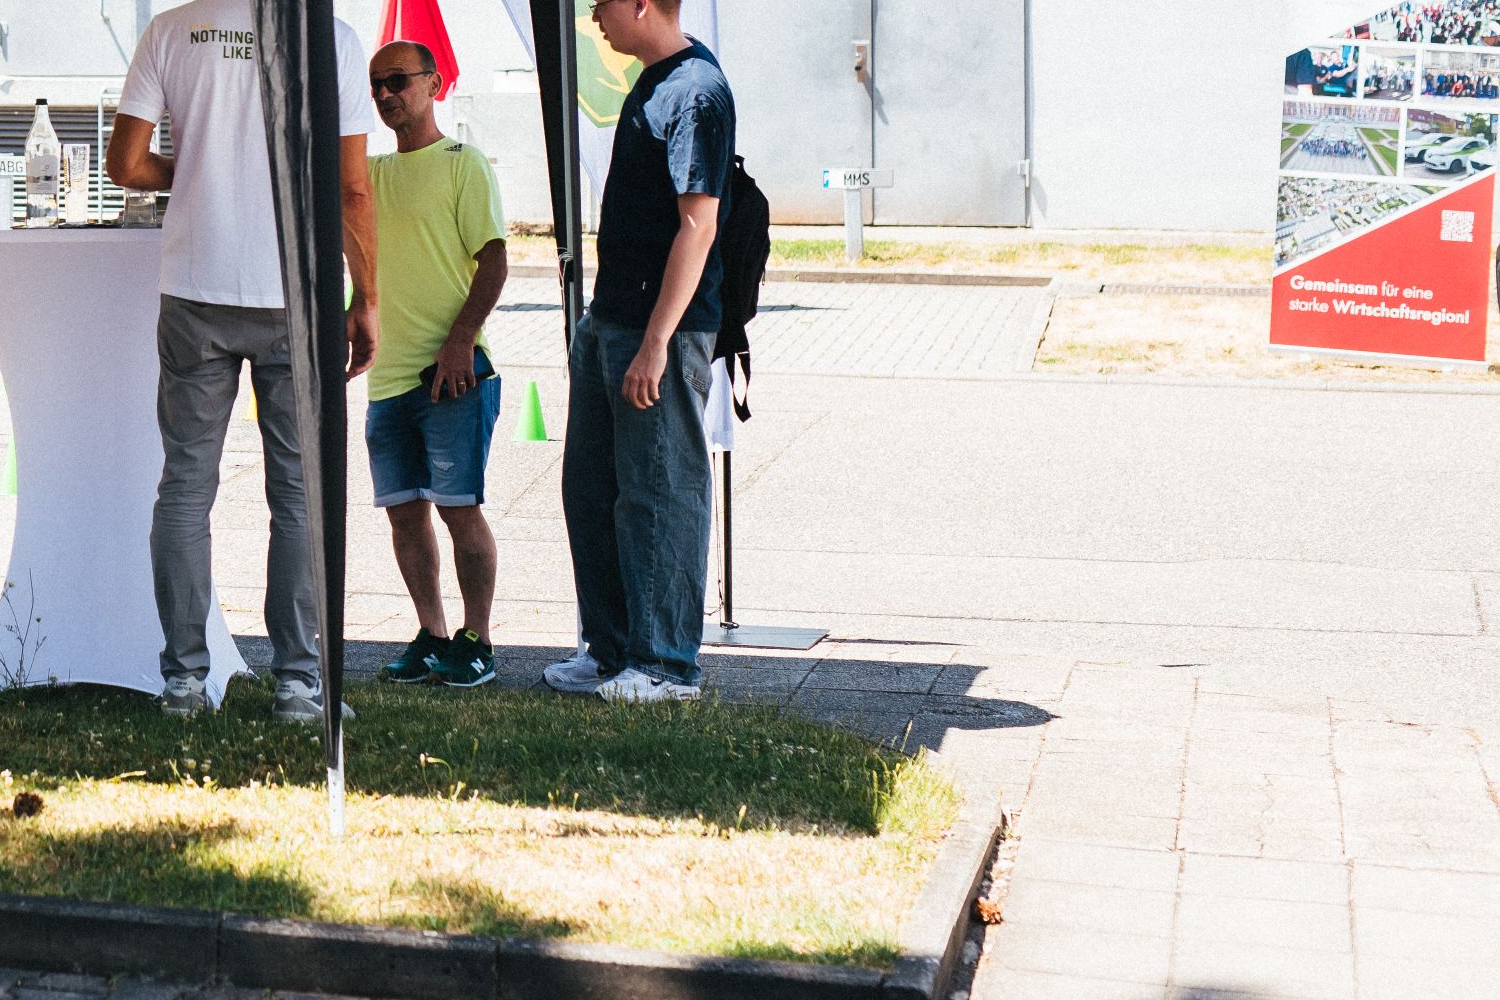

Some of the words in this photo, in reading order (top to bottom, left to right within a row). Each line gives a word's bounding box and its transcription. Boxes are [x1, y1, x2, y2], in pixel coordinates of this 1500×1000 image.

[190, 29, 254, 45] NOTHING
[223, 45, 253, 60] LIKE
[843, 172, 870, 186] MMS
[1289, 275, 1378, 295] Gemeinsam
[1381, 280, 1400, 297] für
[1402, 286, 1433, 300] eine
[1288, 297, 1329, 313] starke
